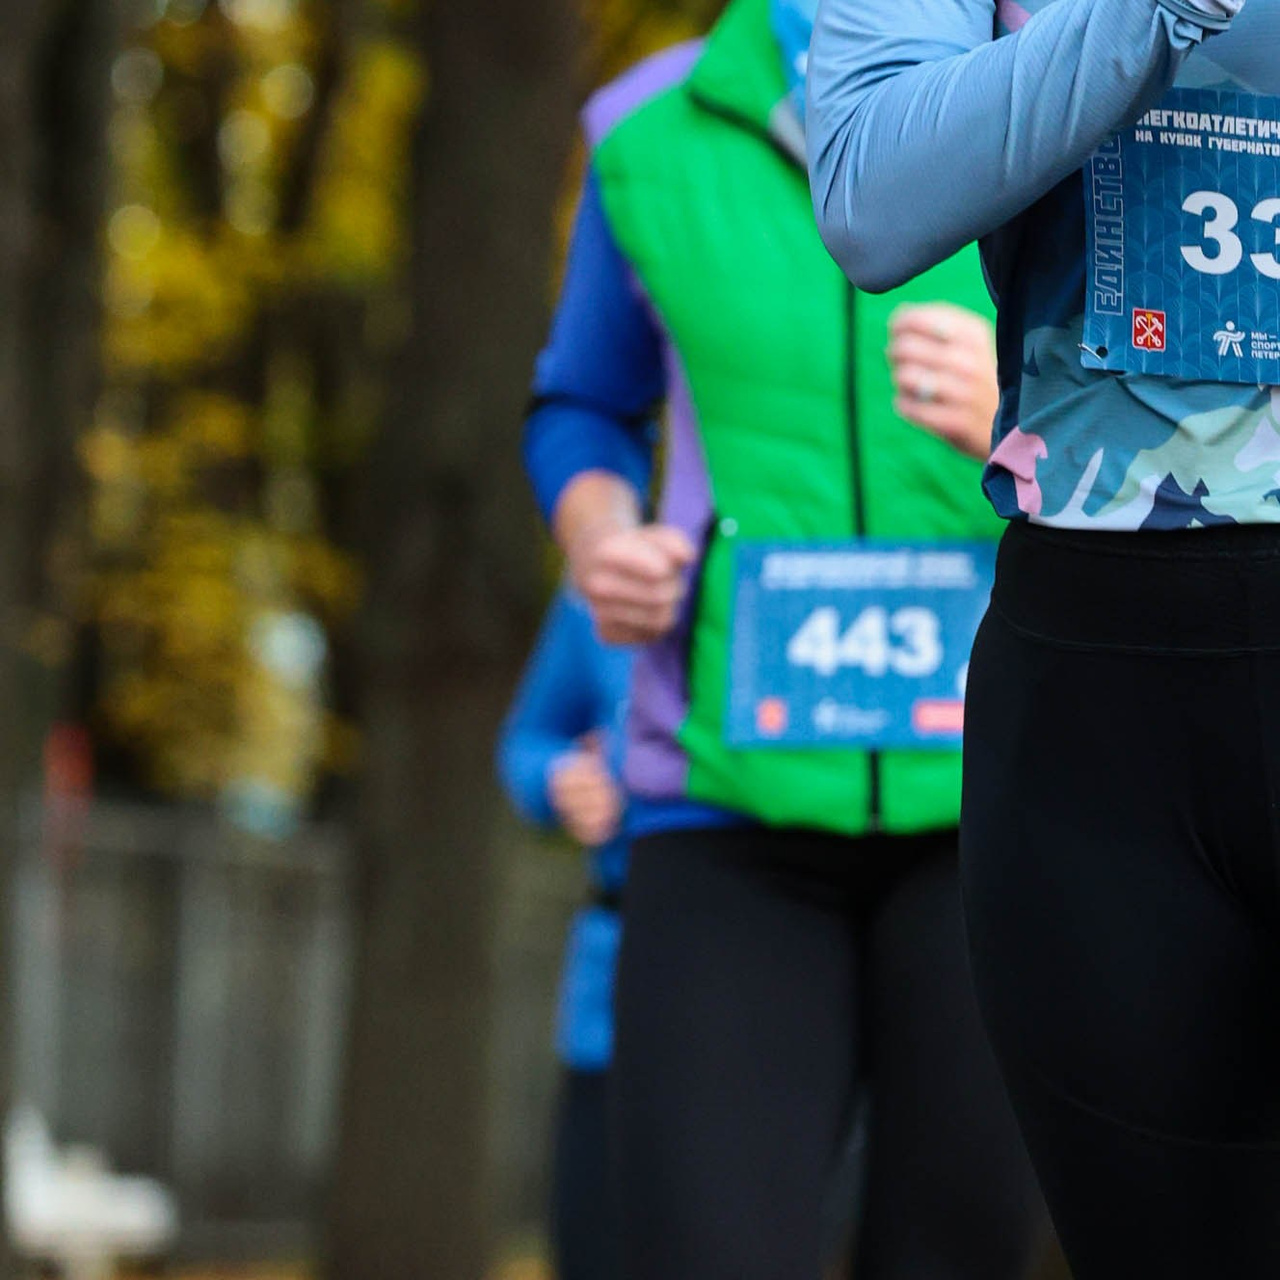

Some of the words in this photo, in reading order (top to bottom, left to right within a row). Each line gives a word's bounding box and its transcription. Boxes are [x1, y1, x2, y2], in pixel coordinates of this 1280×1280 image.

[1135, 130, 1154, 144] НА
[1160, 131, 1202, 148] КУБОК
[787, 606, 943, 678] 443
